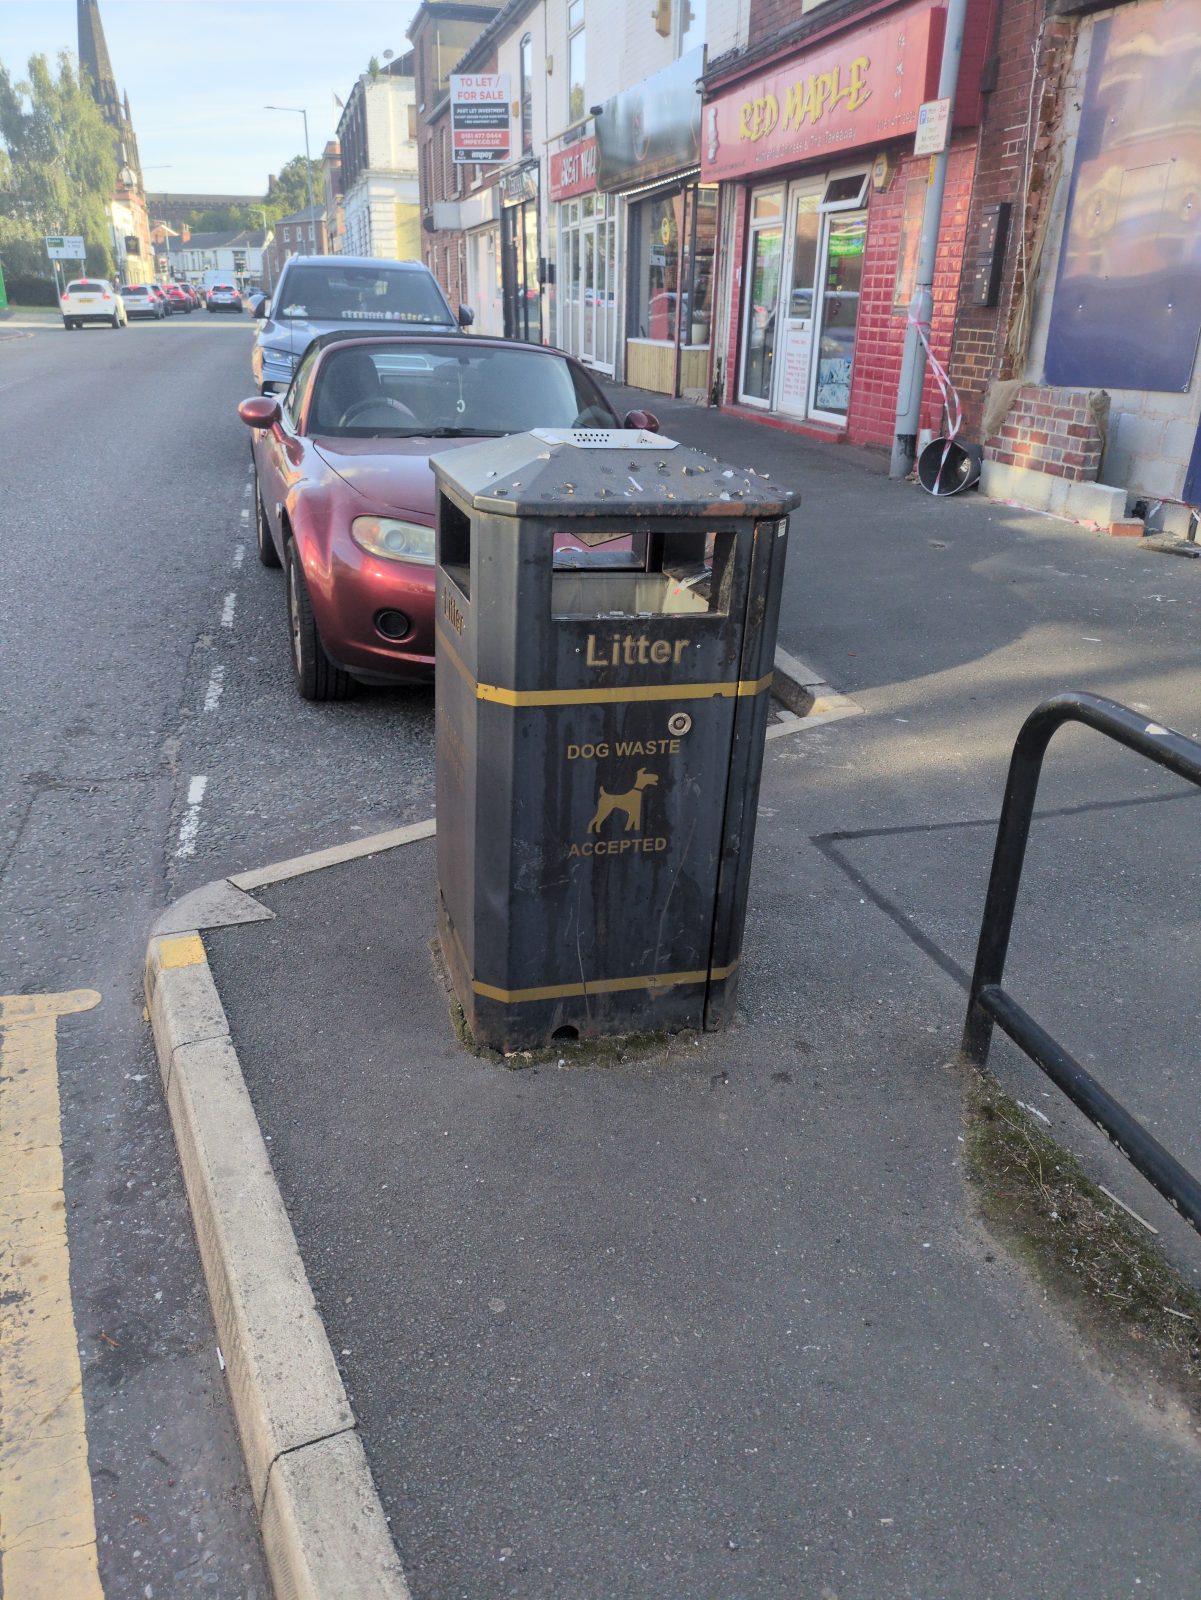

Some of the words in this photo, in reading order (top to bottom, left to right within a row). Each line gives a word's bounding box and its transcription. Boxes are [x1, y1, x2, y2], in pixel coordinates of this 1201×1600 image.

[460, 78, 472, 87] TO
[476, 77, 493, 87] LET
[457, 91, 477, 100] FOR
[480, 91, 504, 100] SALE
[740, 94, 779, 142] RED
[783, 56, 873, 132] MAPLE
[443, 586, 465, 639] Litter
[586, 634, 690, 667] Litter
[567, 743, 609, 760] DOG
[615, 739, 681, 757] WASTE
[568, 837, 668, 857] ACCEPTED
